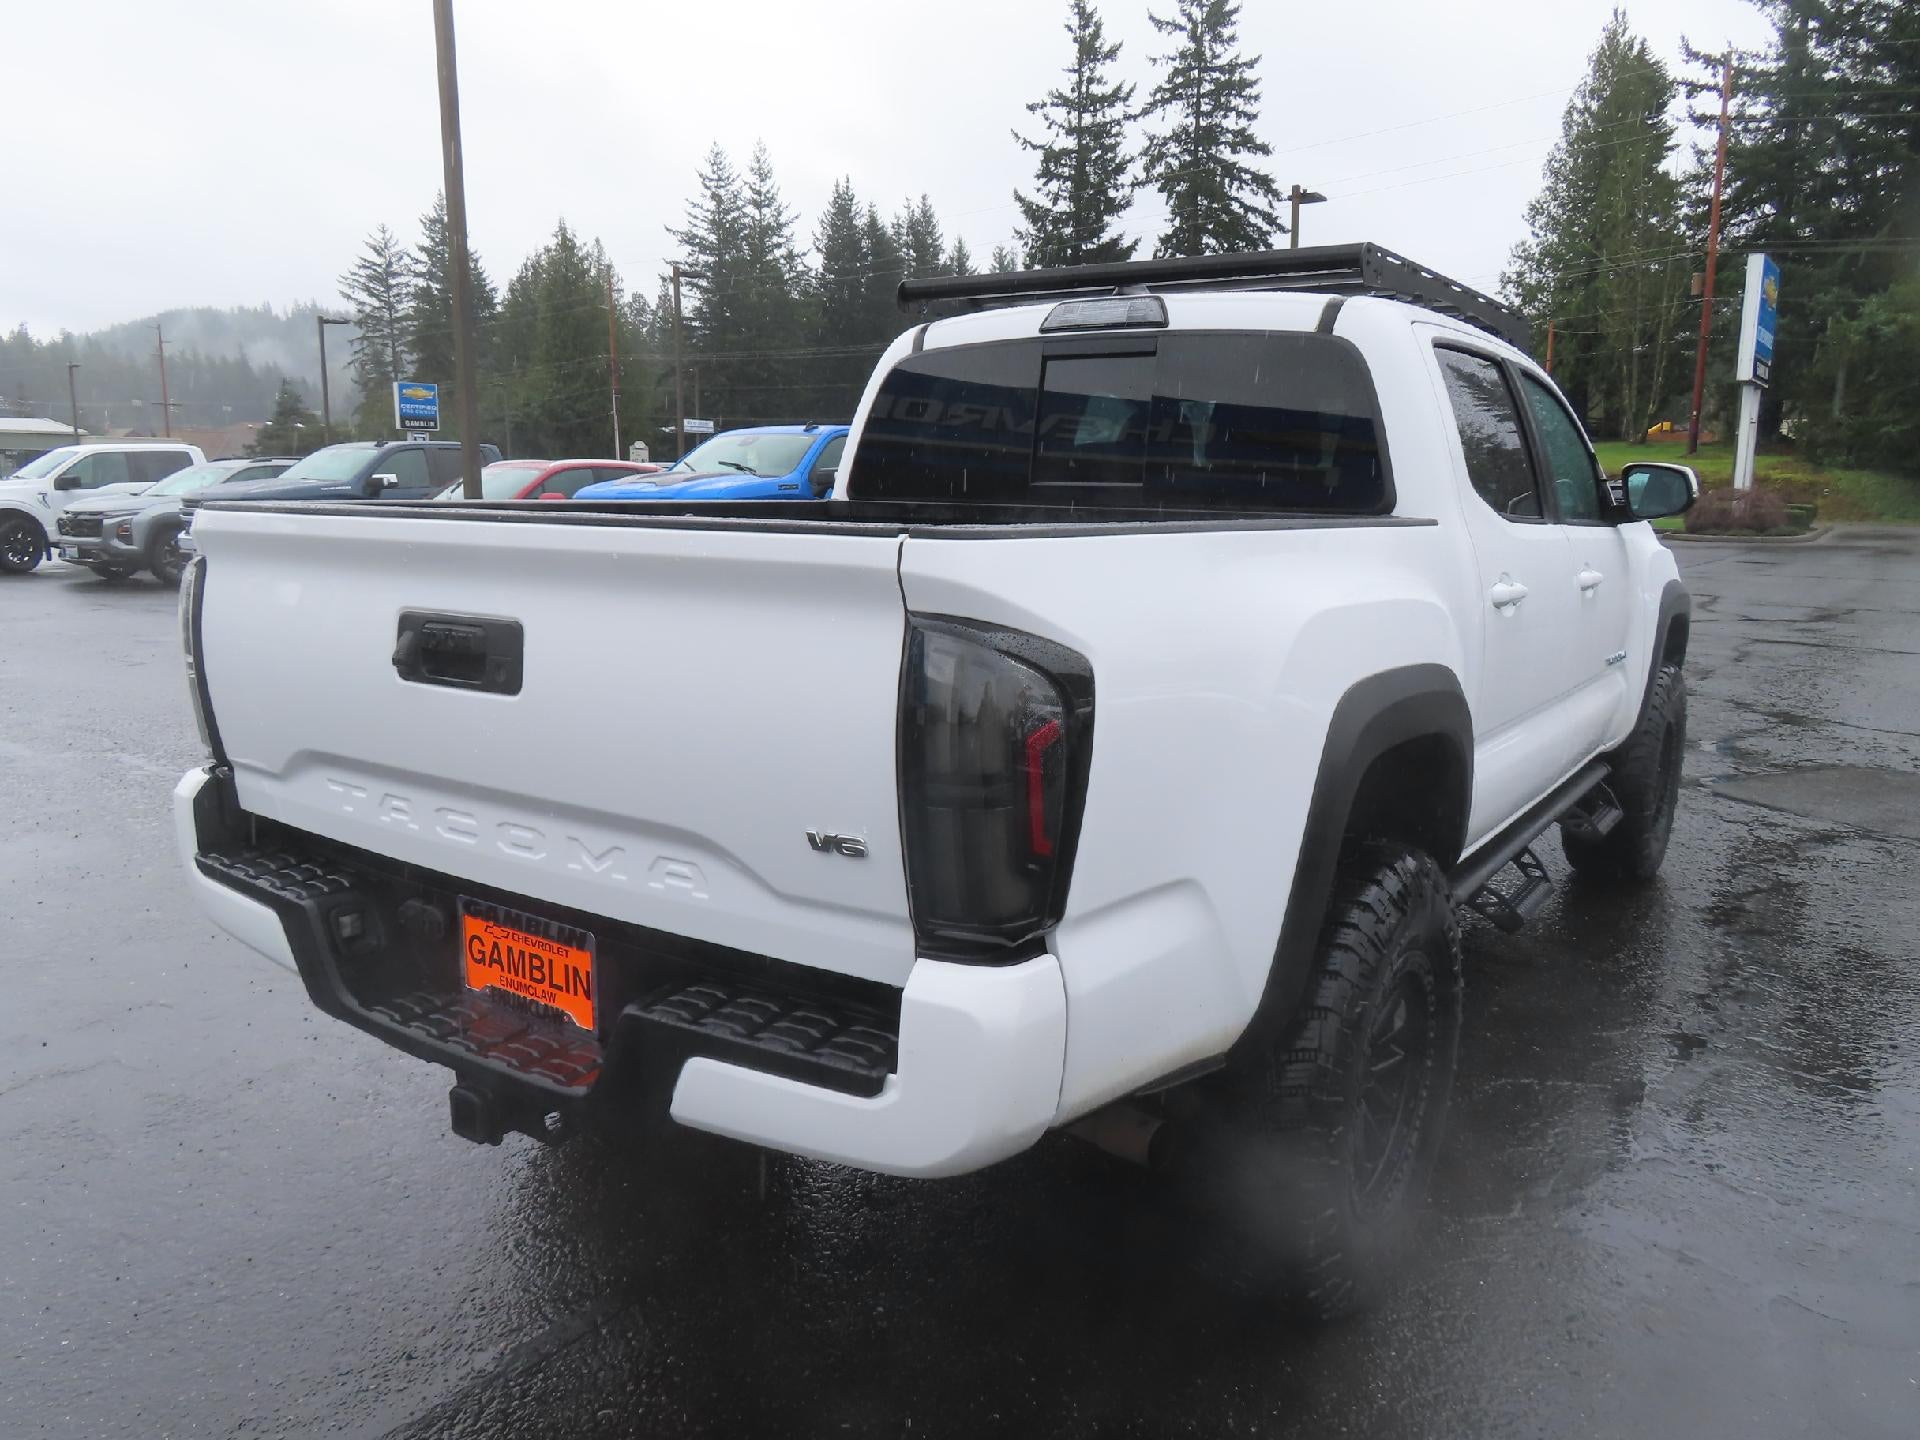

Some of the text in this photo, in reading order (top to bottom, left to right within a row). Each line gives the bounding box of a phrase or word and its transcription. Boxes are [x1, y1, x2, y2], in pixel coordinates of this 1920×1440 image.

[326, 777, 709, 900] TACOMA
[805, 829, 869, 858] V6
[511, 931, 570, 959] CHEVROLET
[467, 933, 592, 1001] GAMBLIN
[499, 974, 557, 1004] ENUMCLAW
